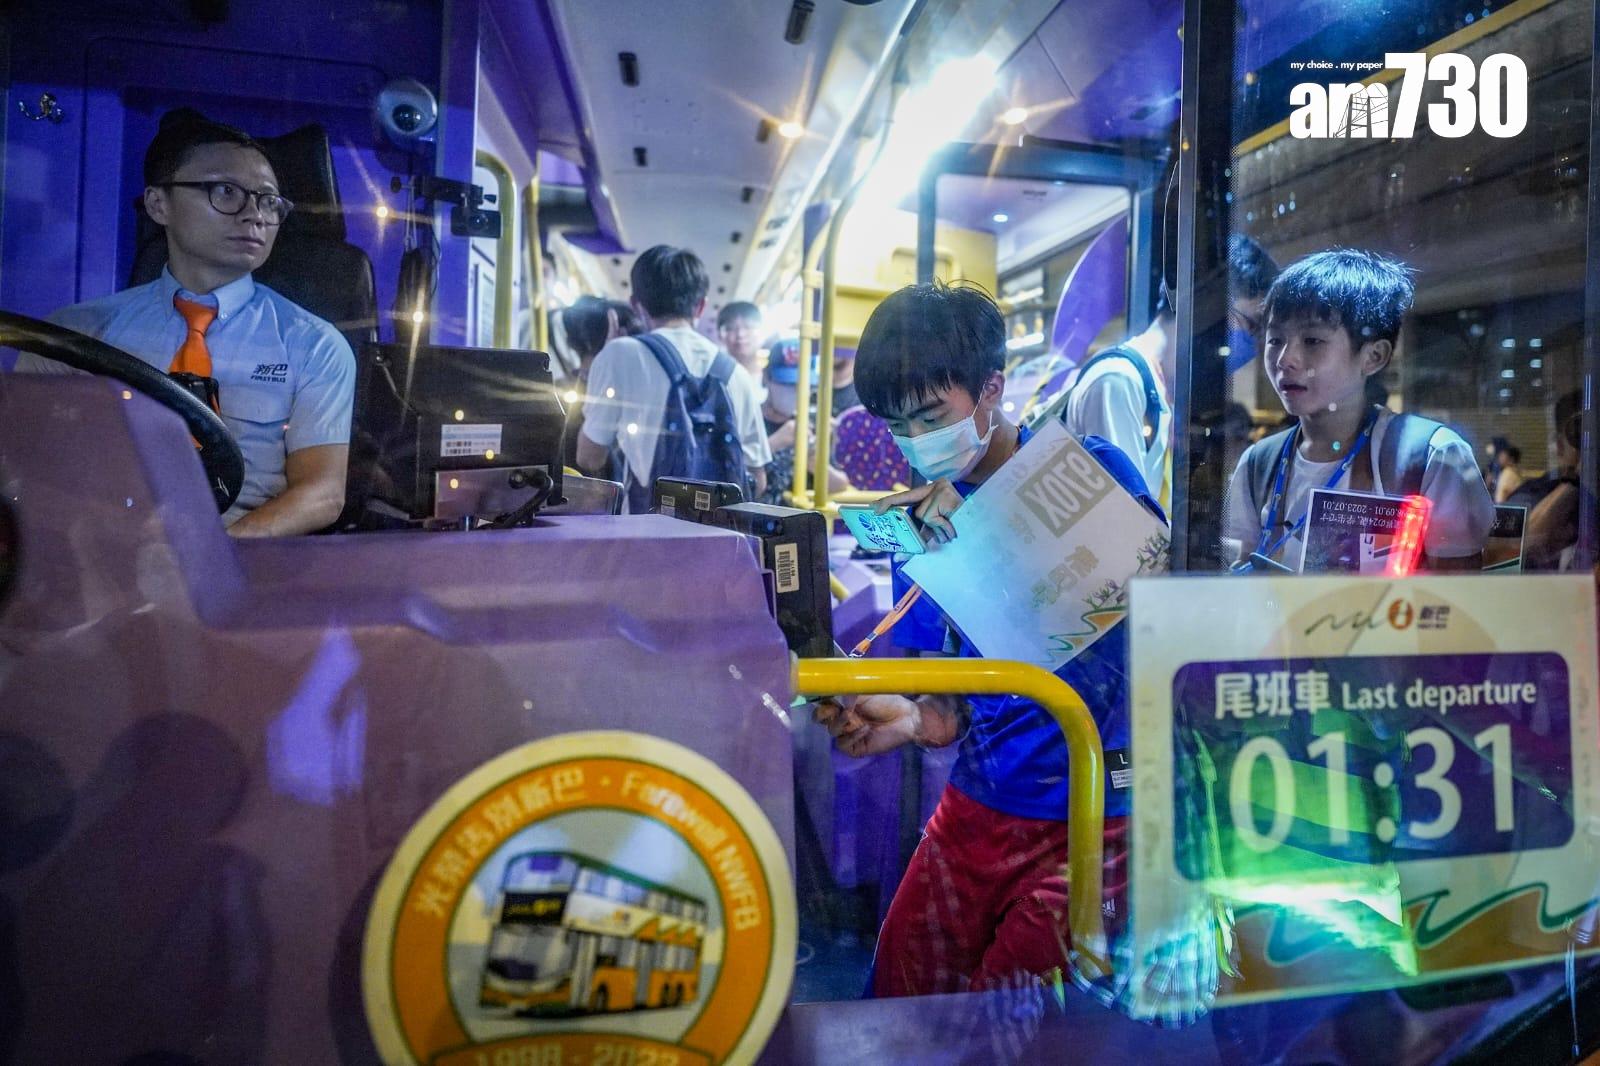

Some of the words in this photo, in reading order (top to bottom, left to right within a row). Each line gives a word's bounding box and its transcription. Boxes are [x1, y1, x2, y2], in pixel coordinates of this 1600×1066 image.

[1322, 500, 1367, 514] 2023.07.01
[1214, 669, 1332, 720] 尾班車
[1342, 682, 1398, 711] Last
[1404, 677, 1538, 715] departure
[1229, 723, 1515, 855] 01:31
